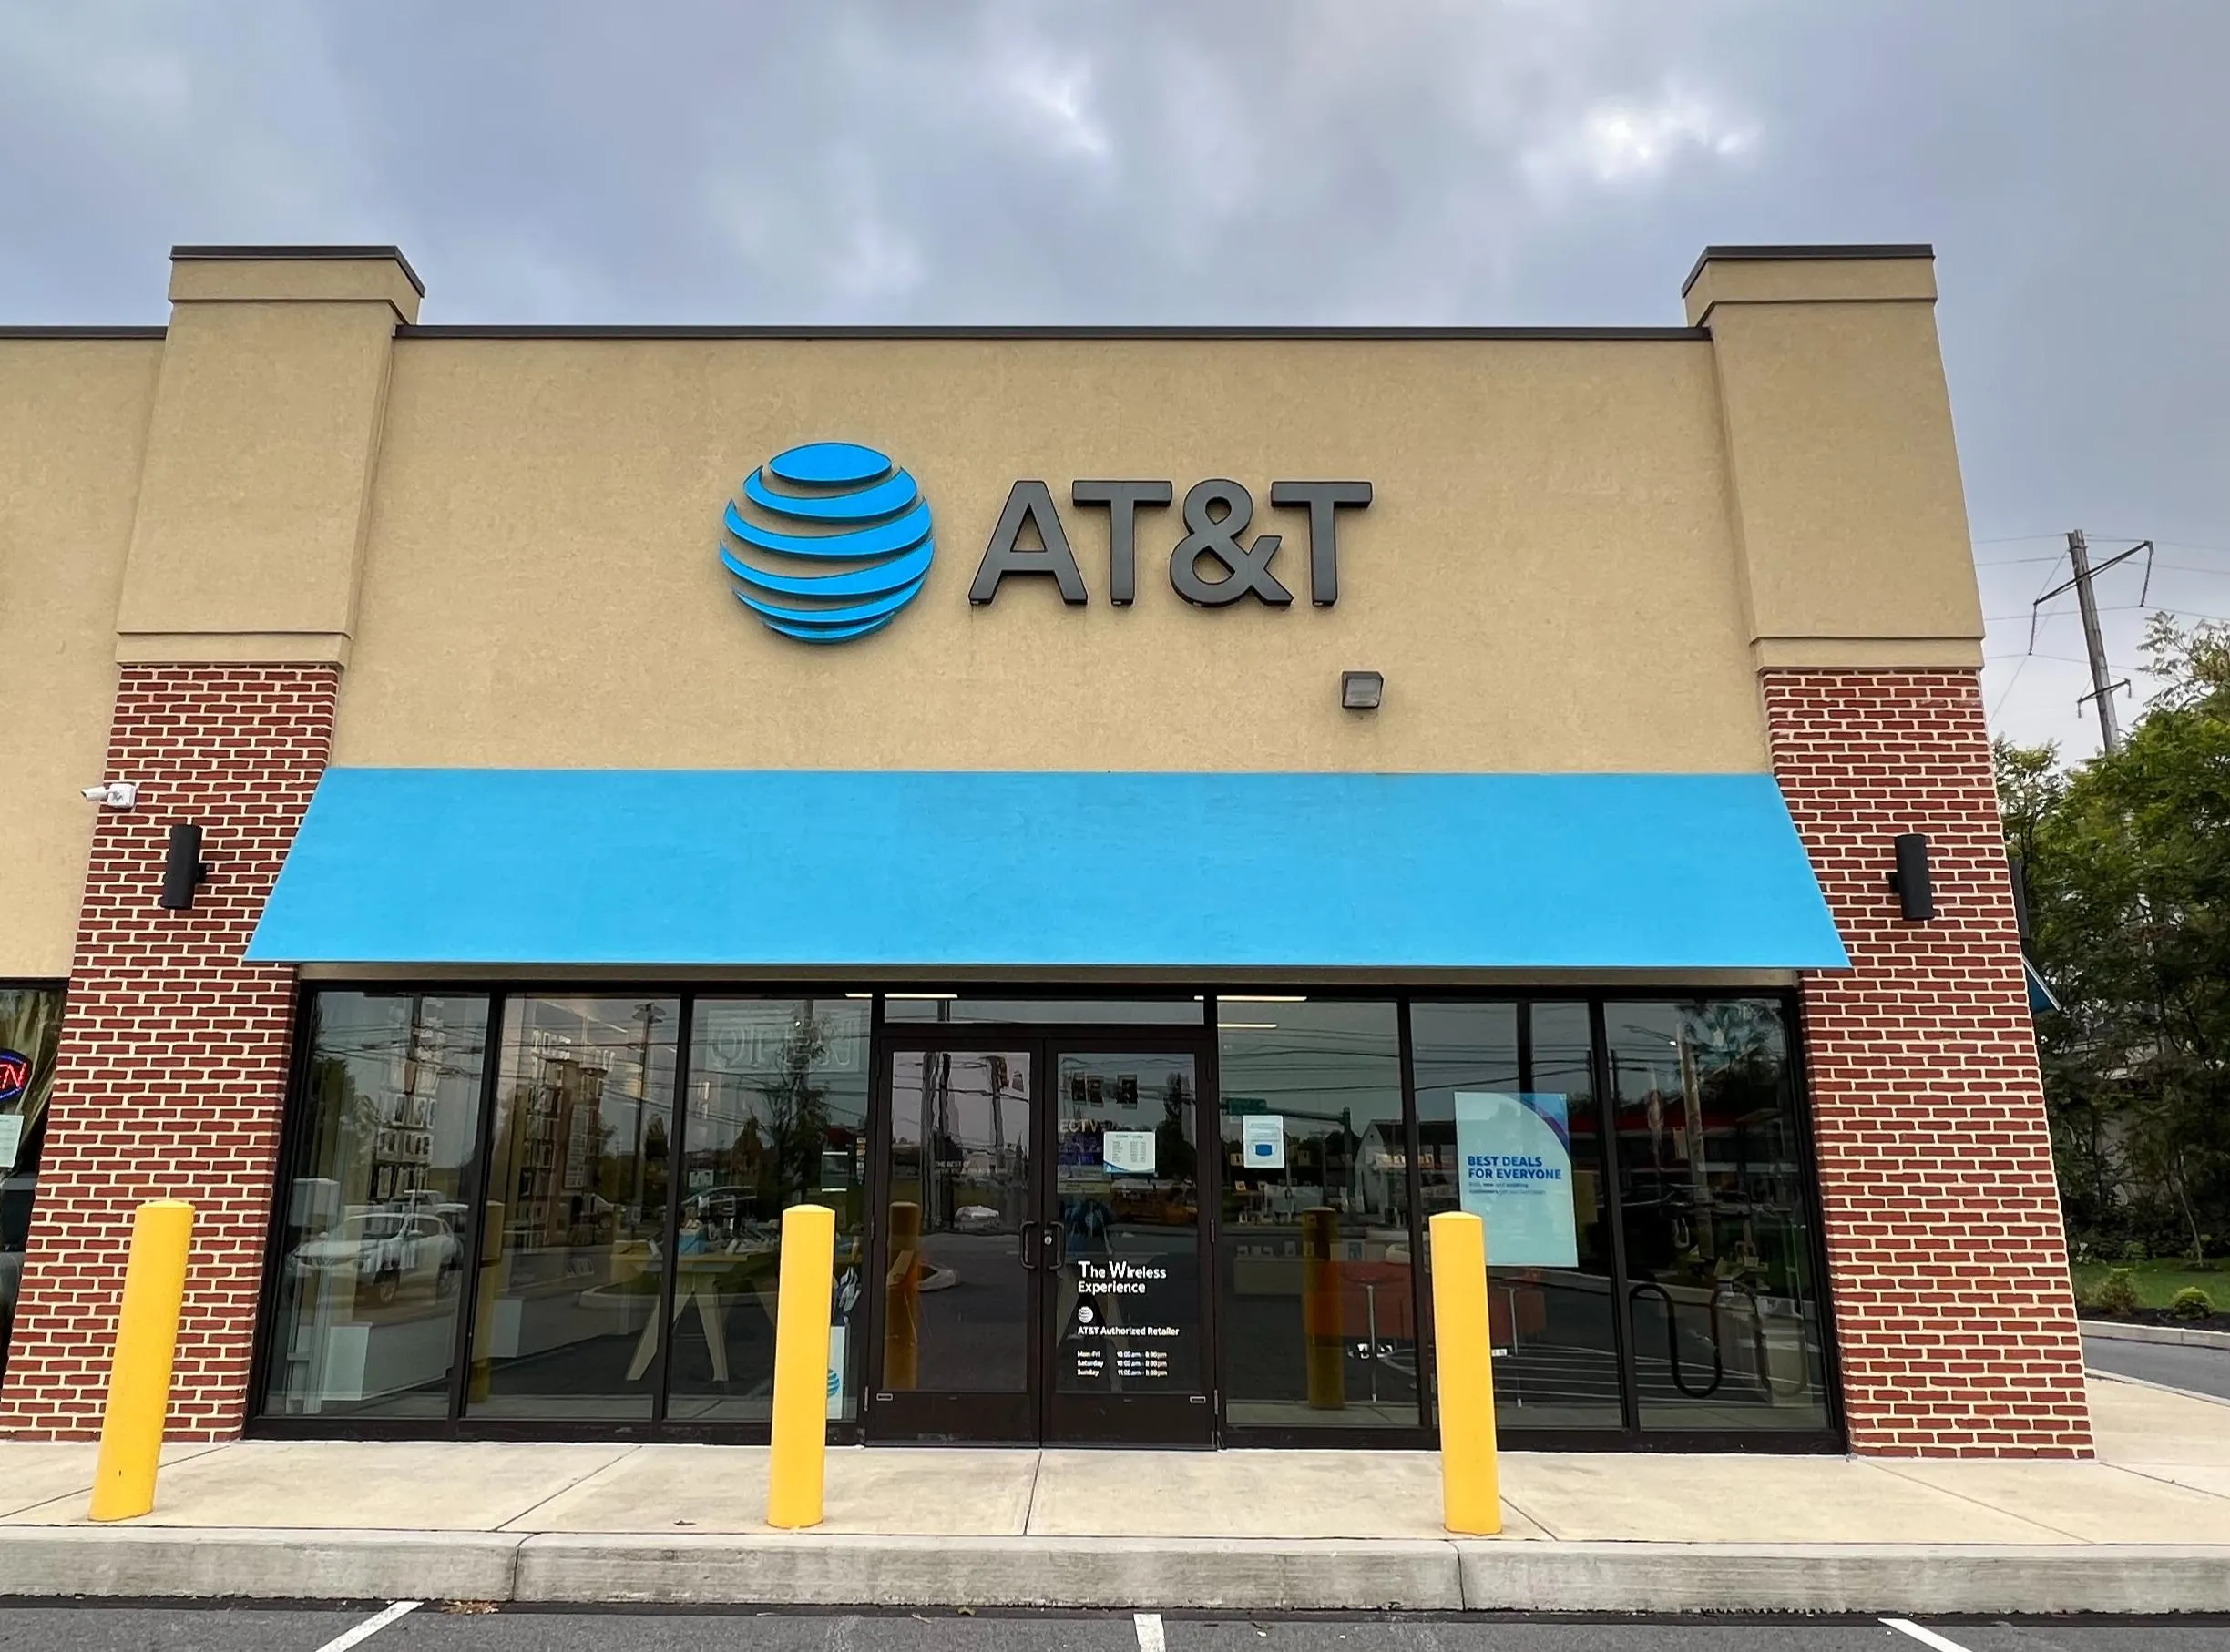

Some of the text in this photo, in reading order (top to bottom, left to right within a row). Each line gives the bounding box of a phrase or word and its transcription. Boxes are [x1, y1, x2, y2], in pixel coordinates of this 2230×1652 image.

[968, 478, 1373, 607] AT&T
[1468, 1156, 1542, 1167] BEST DEALS
[1468, 1168, 1561, 1179] FOR EVERYONE
[1078, 1260, 1167, 1279] The Wireless
[1078, 1280, 1146, 1295] Experience
[1077, 1326, 1180, 1336] AT&T Authorized Retailer
[1077, 1360, 1103, 1368] Saturday
[1077, 1369, 1099, 1377] Sunday
